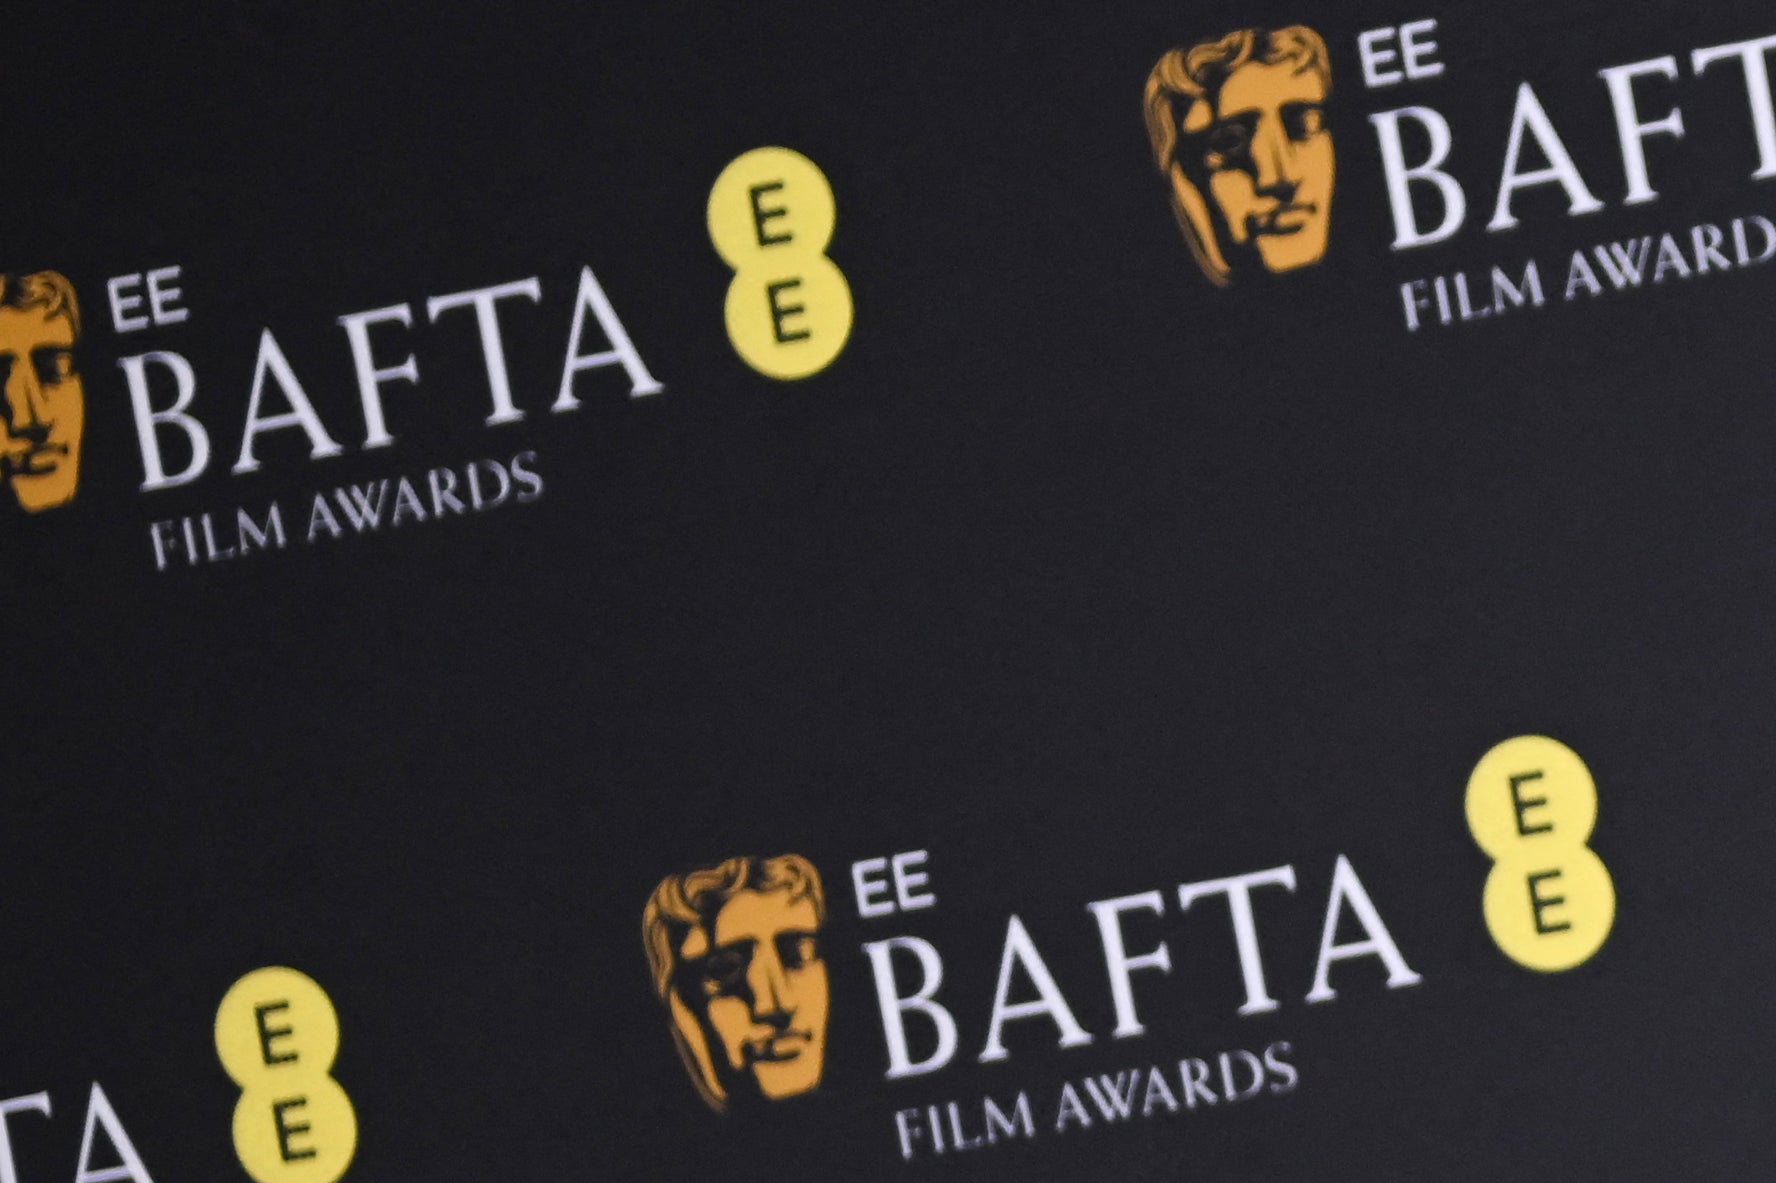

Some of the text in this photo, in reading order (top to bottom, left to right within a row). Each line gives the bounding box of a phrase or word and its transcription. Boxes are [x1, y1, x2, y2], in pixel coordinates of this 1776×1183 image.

[1356, 17, 1446, 89] EE
[105, 264, 190, 334] EE
[1399, 259, 1546, 332] FILM
[117, 264, 665, 492] BAFTA
[149, 450, 545, 571] FILM AWARDS
[850, 848, 937, 919] EE
[862, 852, 1423, 1081] BAFTA
[894, 1042, 1299, 1160] FILM AWARDS
